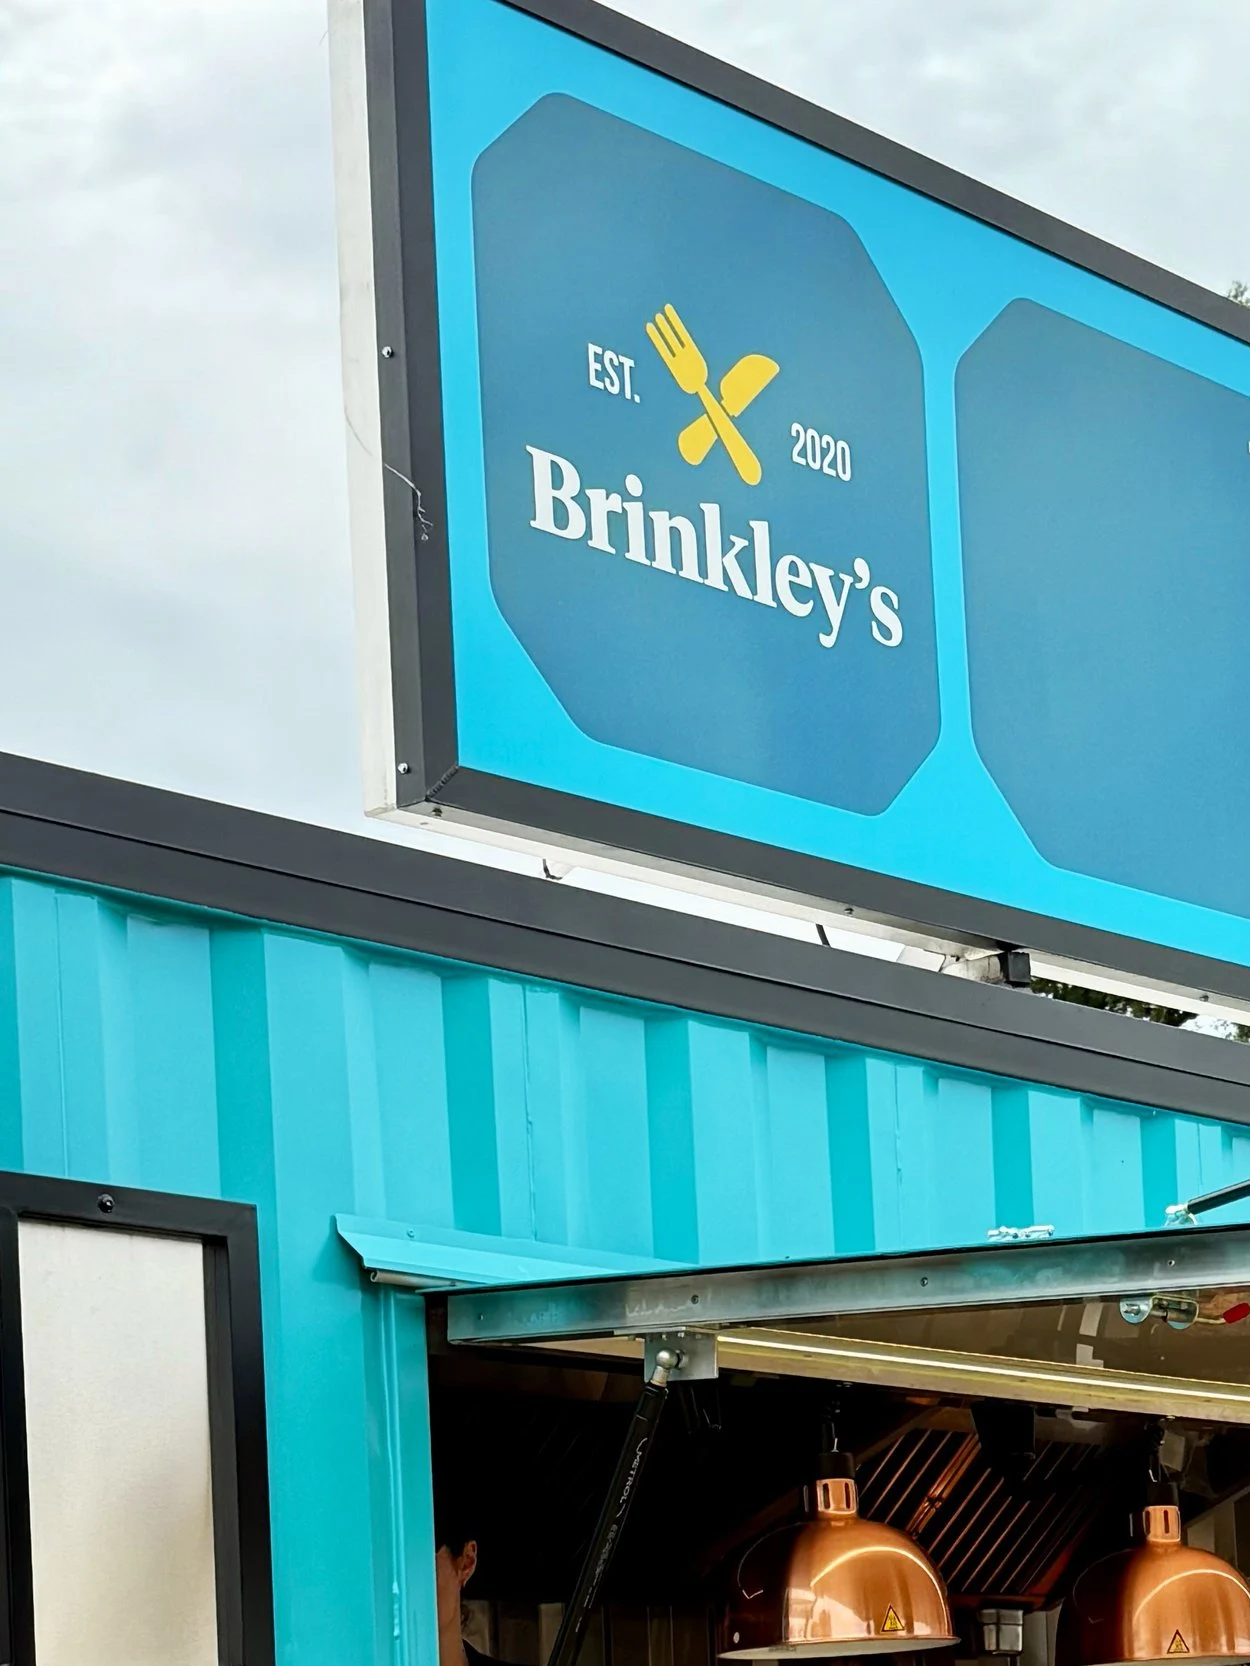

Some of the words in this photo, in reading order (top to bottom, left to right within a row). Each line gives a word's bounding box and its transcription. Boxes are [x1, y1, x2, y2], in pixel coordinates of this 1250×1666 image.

[587, 342, 641, 404] EST.
[790, 422, 852, 482] 2020
[525, 444, 904, 649] Brinkley's
[620, 1450, 643, 1504] METROL
